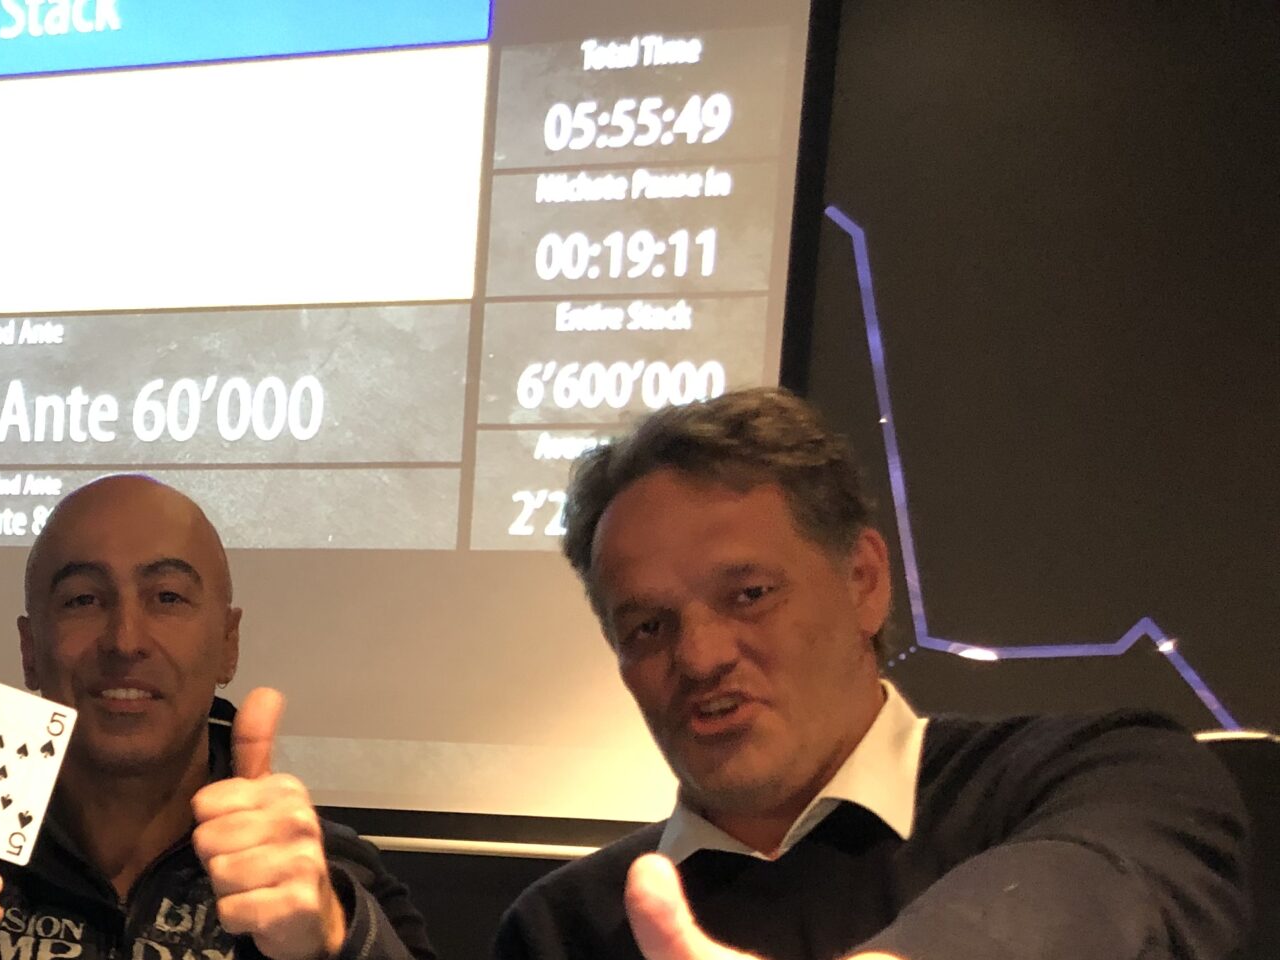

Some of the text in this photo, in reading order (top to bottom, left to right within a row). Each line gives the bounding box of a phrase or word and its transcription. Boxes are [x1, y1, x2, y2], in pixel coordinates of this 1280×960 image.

[0, 0, 122, 39] Stack
[544, 92, 731, 151] 05:55:49
[535, 229, 716, 281] 00:19:11
[46, 712, 67, 737] 5
[6, 831, 27, 856] 5
